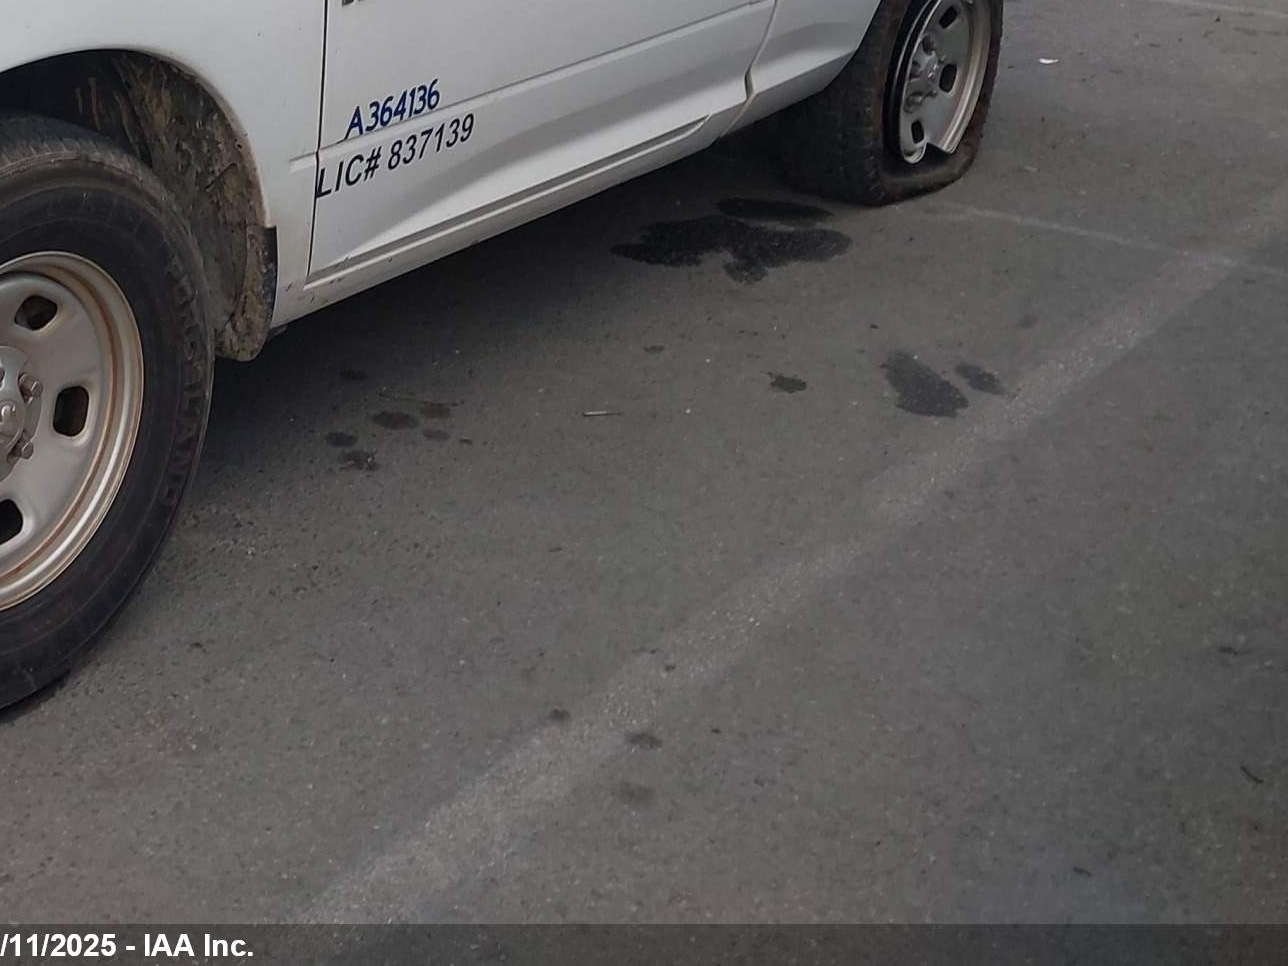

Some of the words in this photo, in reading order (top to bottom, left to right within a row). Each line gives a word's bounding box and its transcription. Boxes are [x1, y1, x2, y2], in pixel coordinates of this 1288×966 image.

[343, 78, 441, 141] A364136
[316, 145, 382, 199] LIC#
[387, 113, 475, 171] 837139
